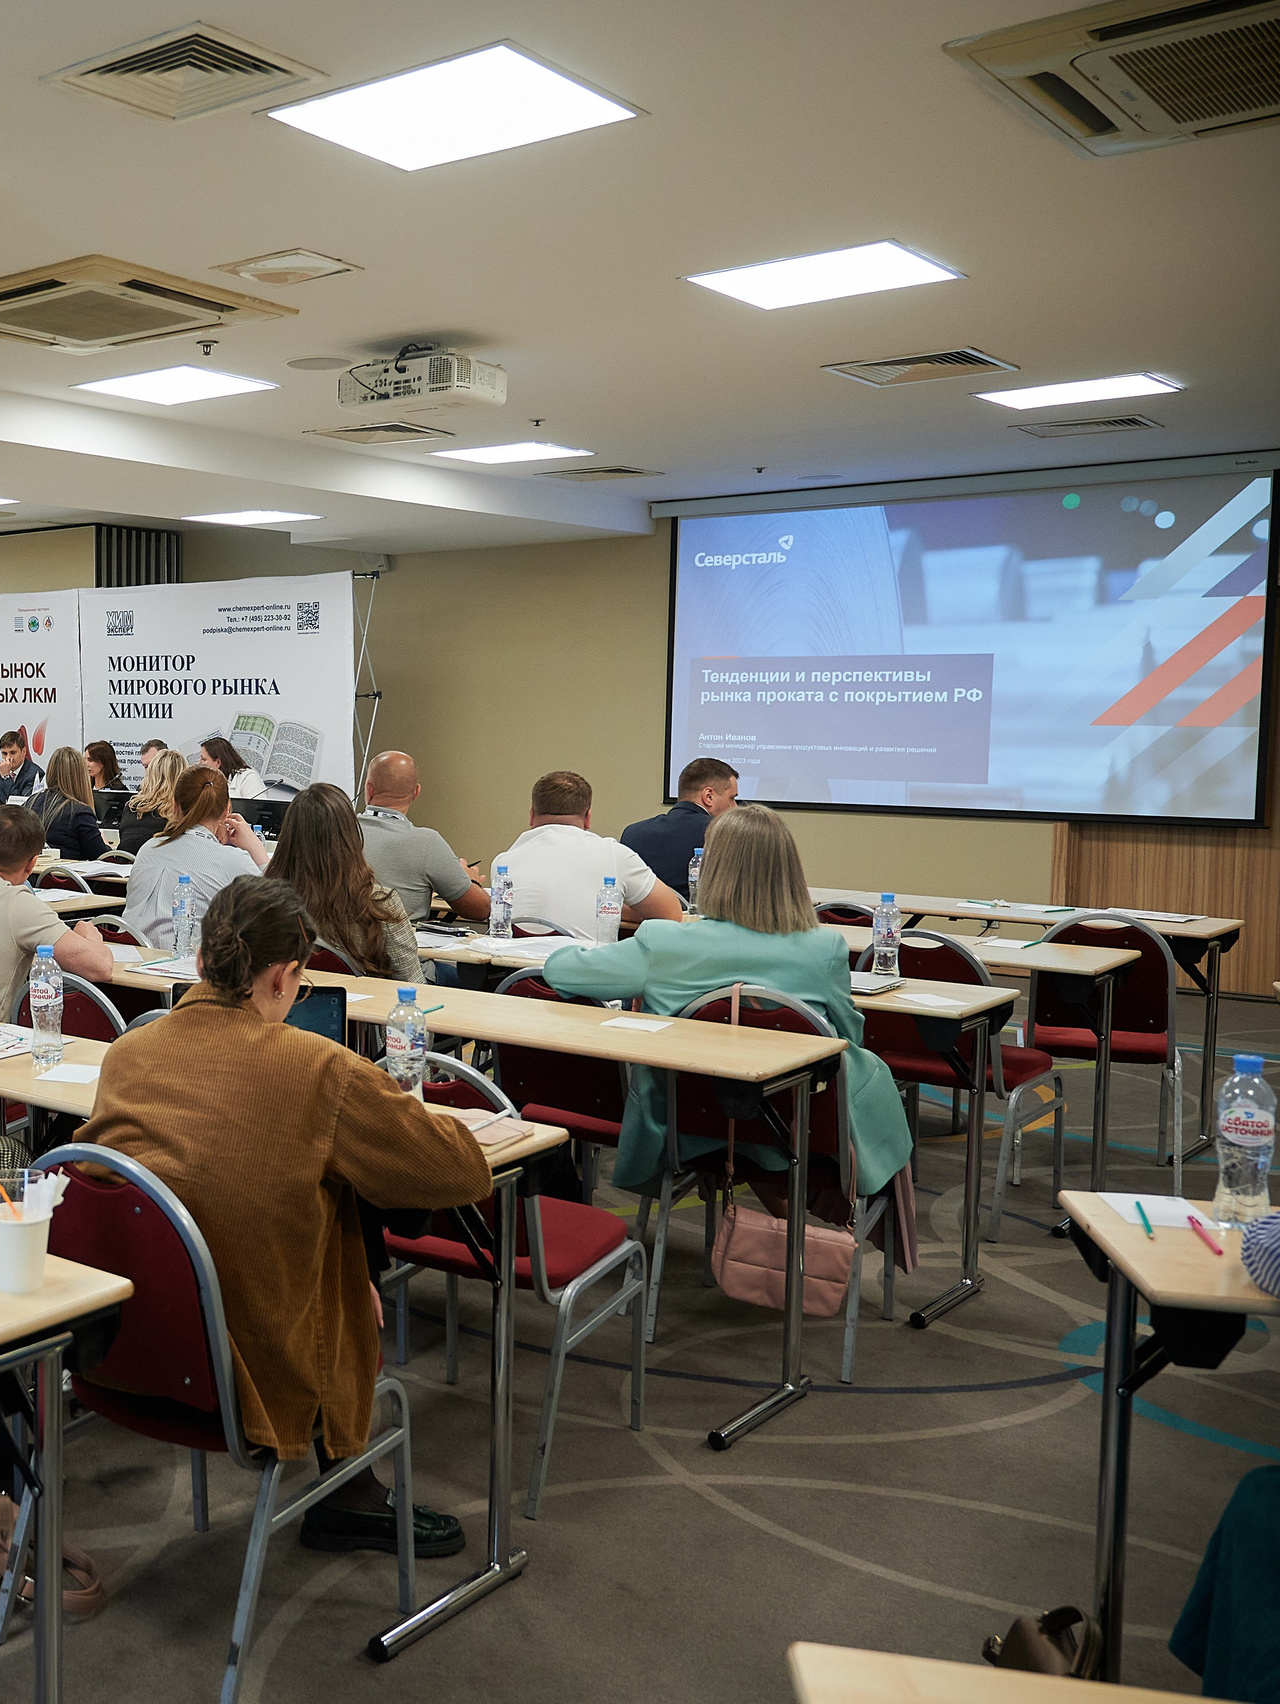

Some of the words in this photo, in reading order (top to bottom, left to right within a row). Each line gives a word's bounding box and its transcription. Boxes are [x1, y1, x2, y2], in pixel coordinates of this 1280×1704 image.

[694, 551, 787, 570] Северсталь
[217, 604, 291, 613] www.chemexpert-online.ru
[106, 610, 134, 627] ХИМ
[248, 615, 263, 623] (495)
[263, 614, 291, 622] 223-30-92
[107, 654, 196, 672] МОНИТОР
[701, 669, 790, 685] Тенденции
[795, 671, 805, 682] и
[810, 670, 931, 686] перспективы
[107, 678, 207, 696] МИРОВОГО
[211, 677, 281, 696] РЫНКА
[22, 687, 57, 704] ЛКМ
[700, 689, 752, 705] рынка
[756, 689, 824, 705] проката
[828, 690, 839, 702] с
[844, 689, 948, 706] покрытием
[953, 688, 983, 703] РФ
[108, 702, 174, 720] ХИМИИ
[698, 733, 723, 741] Антон
[725, 733, 757, 742] Иванов
